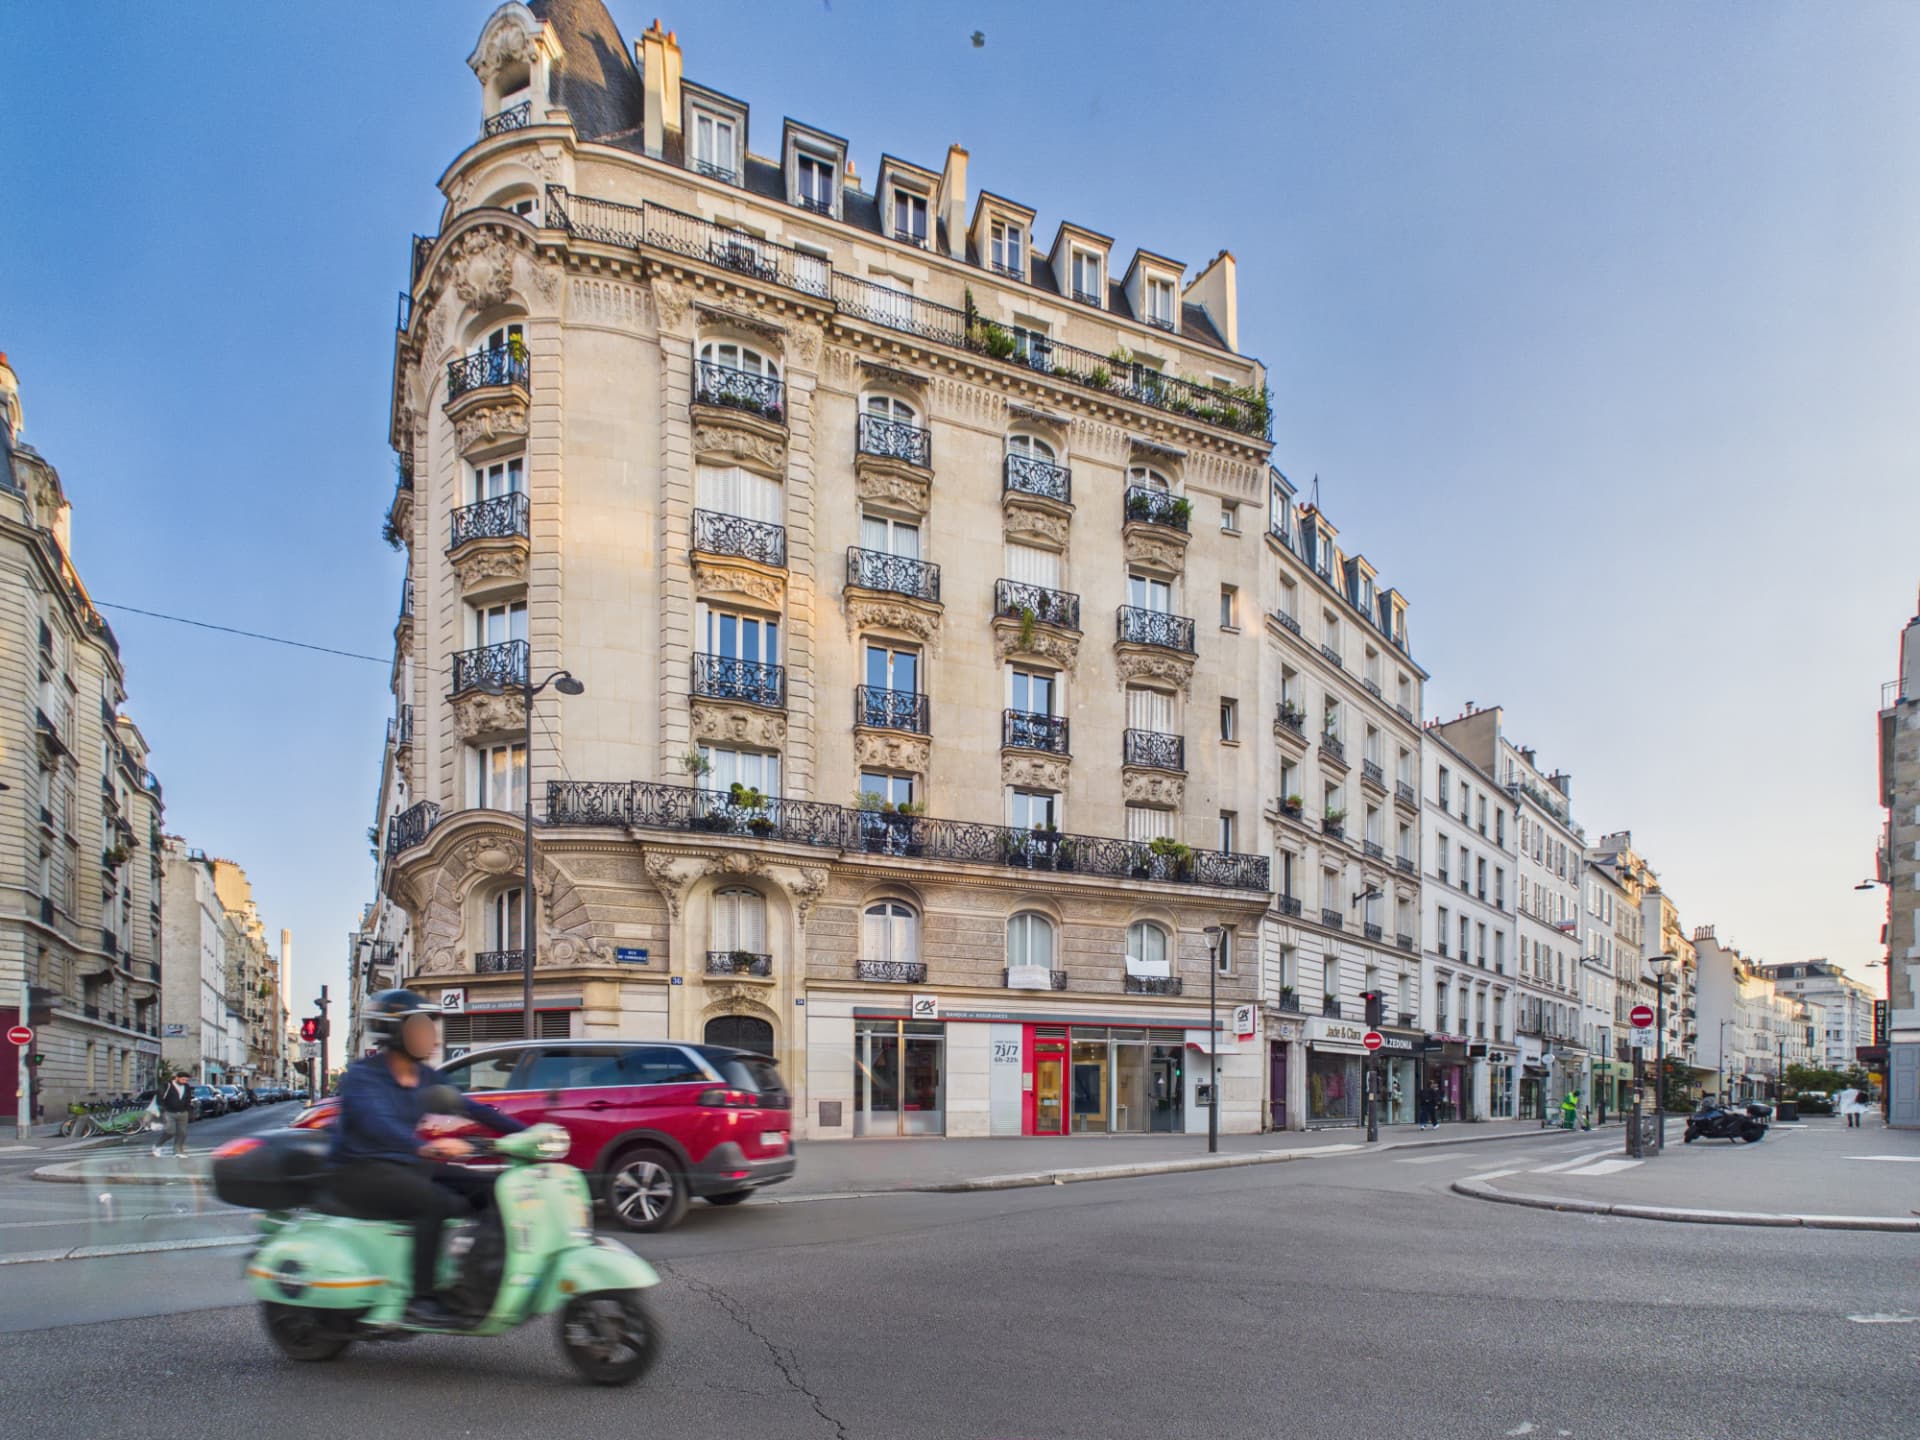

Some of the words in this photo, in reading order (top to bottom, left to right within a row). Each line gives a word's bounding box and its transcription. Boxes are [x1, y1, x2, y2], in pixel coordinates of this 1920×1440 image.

[1326, 1025, 1340, 1037] Jade
[1341, 1027, 1346, 1039] &
[1347, 1028, 1361, 1040] Clara
[1383, 1036, 1413, 1050] ALZEDONIA
[994, 1045, 1018, 1057] 7j/7
